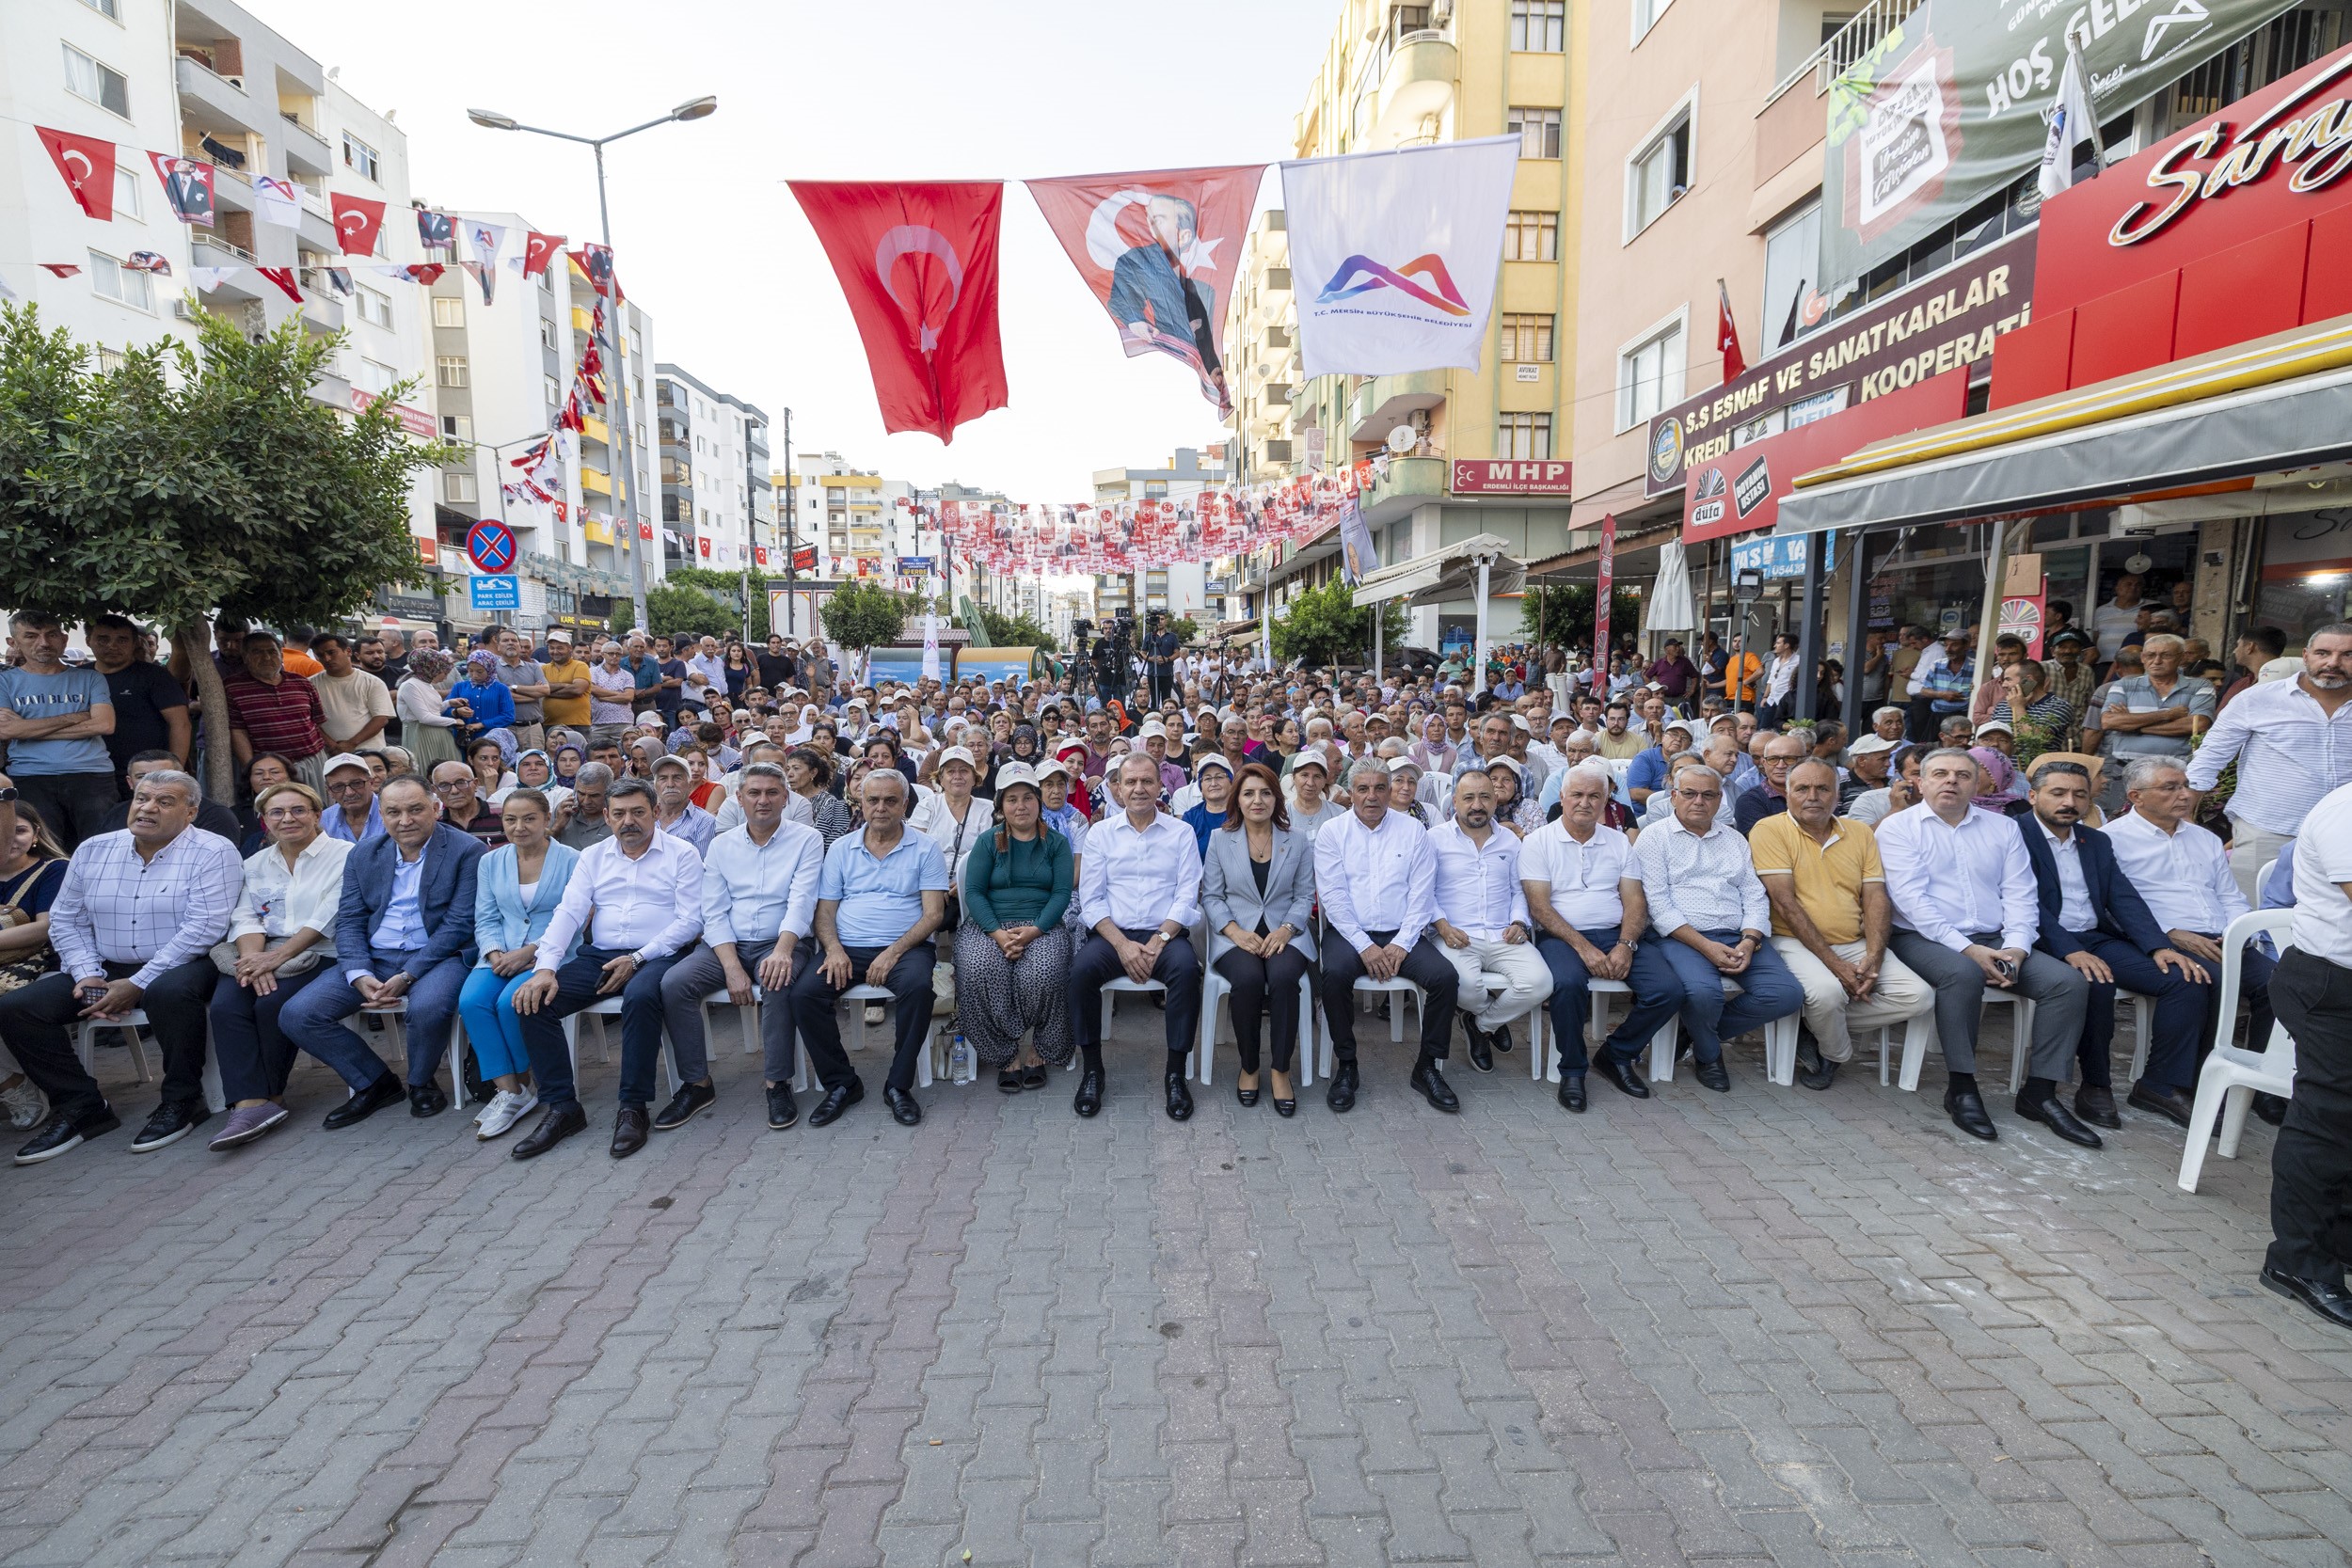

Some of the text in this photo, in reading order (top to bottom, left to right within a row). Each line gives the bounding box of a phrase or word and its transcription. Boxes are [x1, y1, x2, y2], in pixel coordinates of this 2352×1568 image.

[1986, 37, 2054, 119] HOŞ
[2064, 0, 2152, 52] GEL
[1366, 310, 1422, 322] BÜYÜKŞEHİR
[1424, 318, 1472, 328] BELEDİYESİ
[1712, 377, 1770, 423] ESNAF
[1776, 360, 1803, 394] VE
[1808, 264, 2010, 380] SANATKARLAR
[1684, 428, 1730, 470] KREDİ
[1488, 463, 1565, 481] MHP
[1736, 462, 1766, 499] BOYANIN
[1740, 478, 1766, 509] USTASI
[1695, 504, 1720, 522] düfa
[793, 548, 812, 562] SARAY
[16, 693, 45, 706] MAVİ
